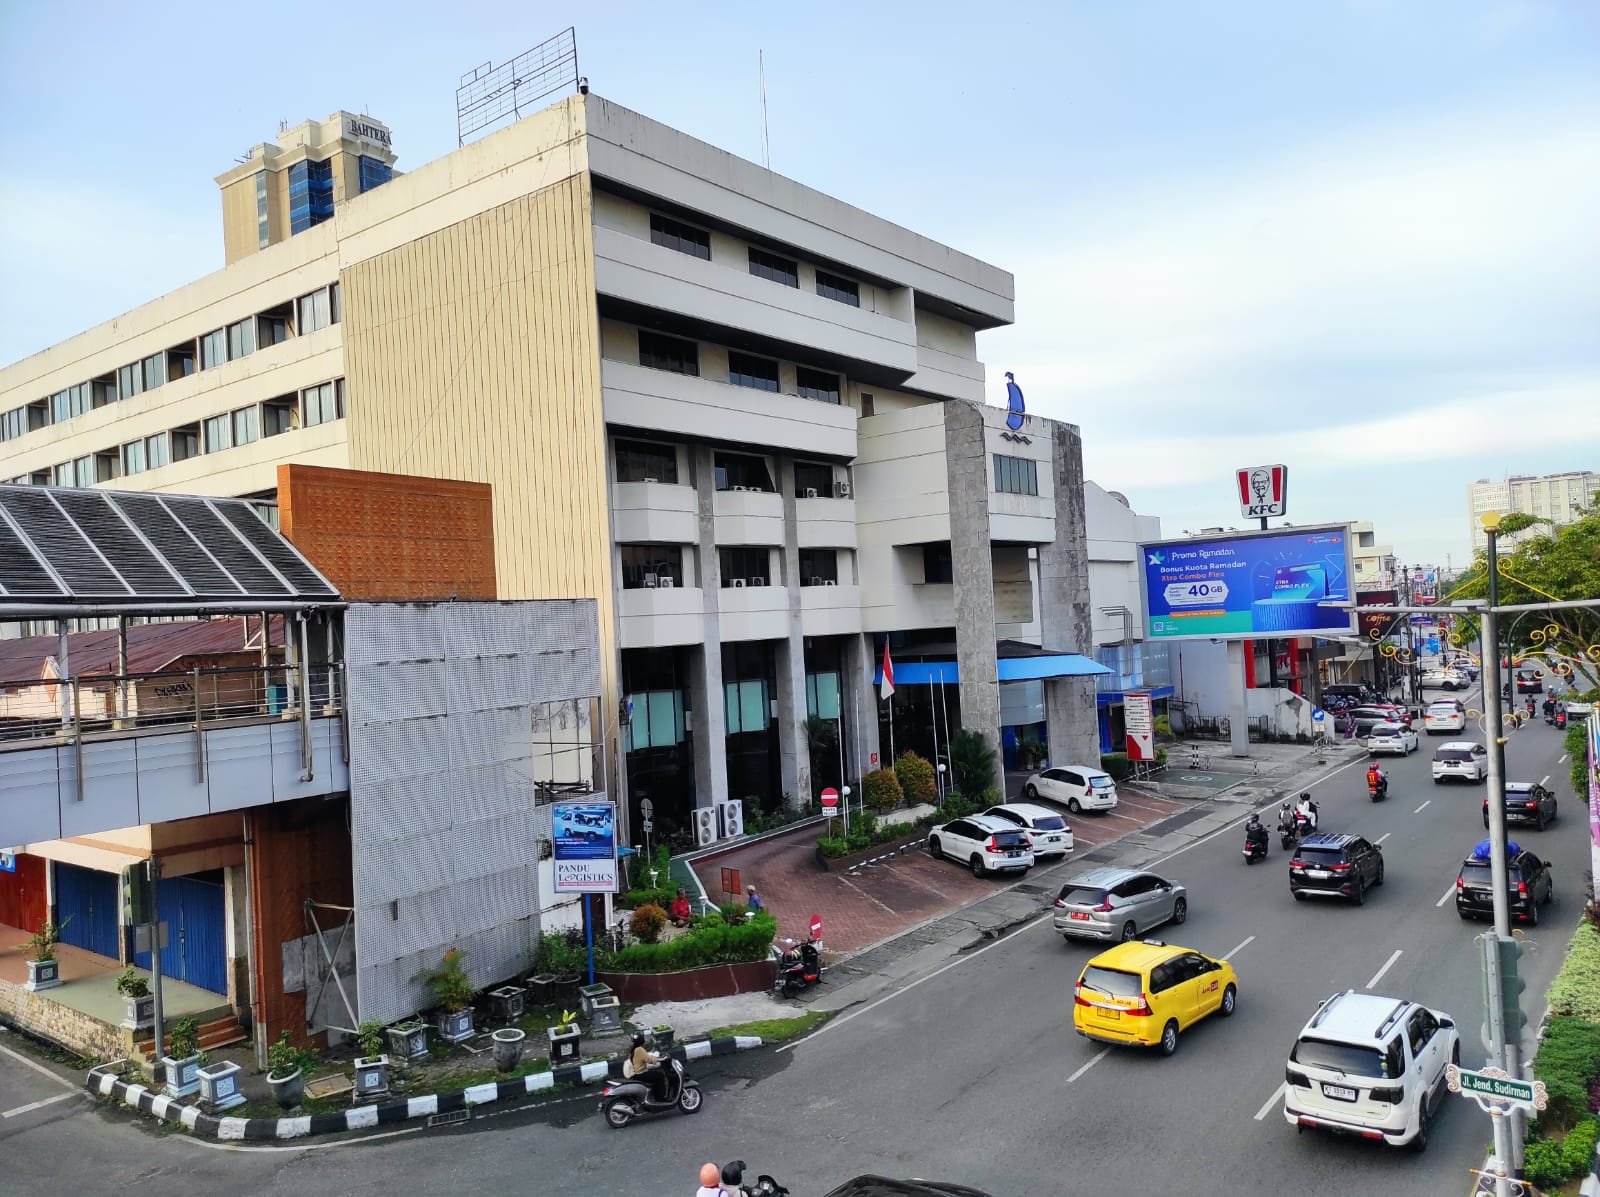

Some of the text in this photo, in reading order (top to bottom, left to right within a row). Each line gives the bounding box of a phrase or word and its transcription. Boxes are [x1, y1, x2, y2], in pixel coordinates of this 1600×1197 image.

[351, 119, 392, 145] BAHTERA
[1248, 504, 1277, 515] KFC
[1172, 549, 1235, 561] Promo Ramadan
[1209, 561, 1247, 570] Ramadan
[1188, 584, 1209, 597] 40
[1210, 585, 1223, 593] GB
[558, 864, 590, 872] PANDU
[1472, 1078, 1493, 1092] Jend.
[1494, 1083, 1531, 1099] Sudirman
